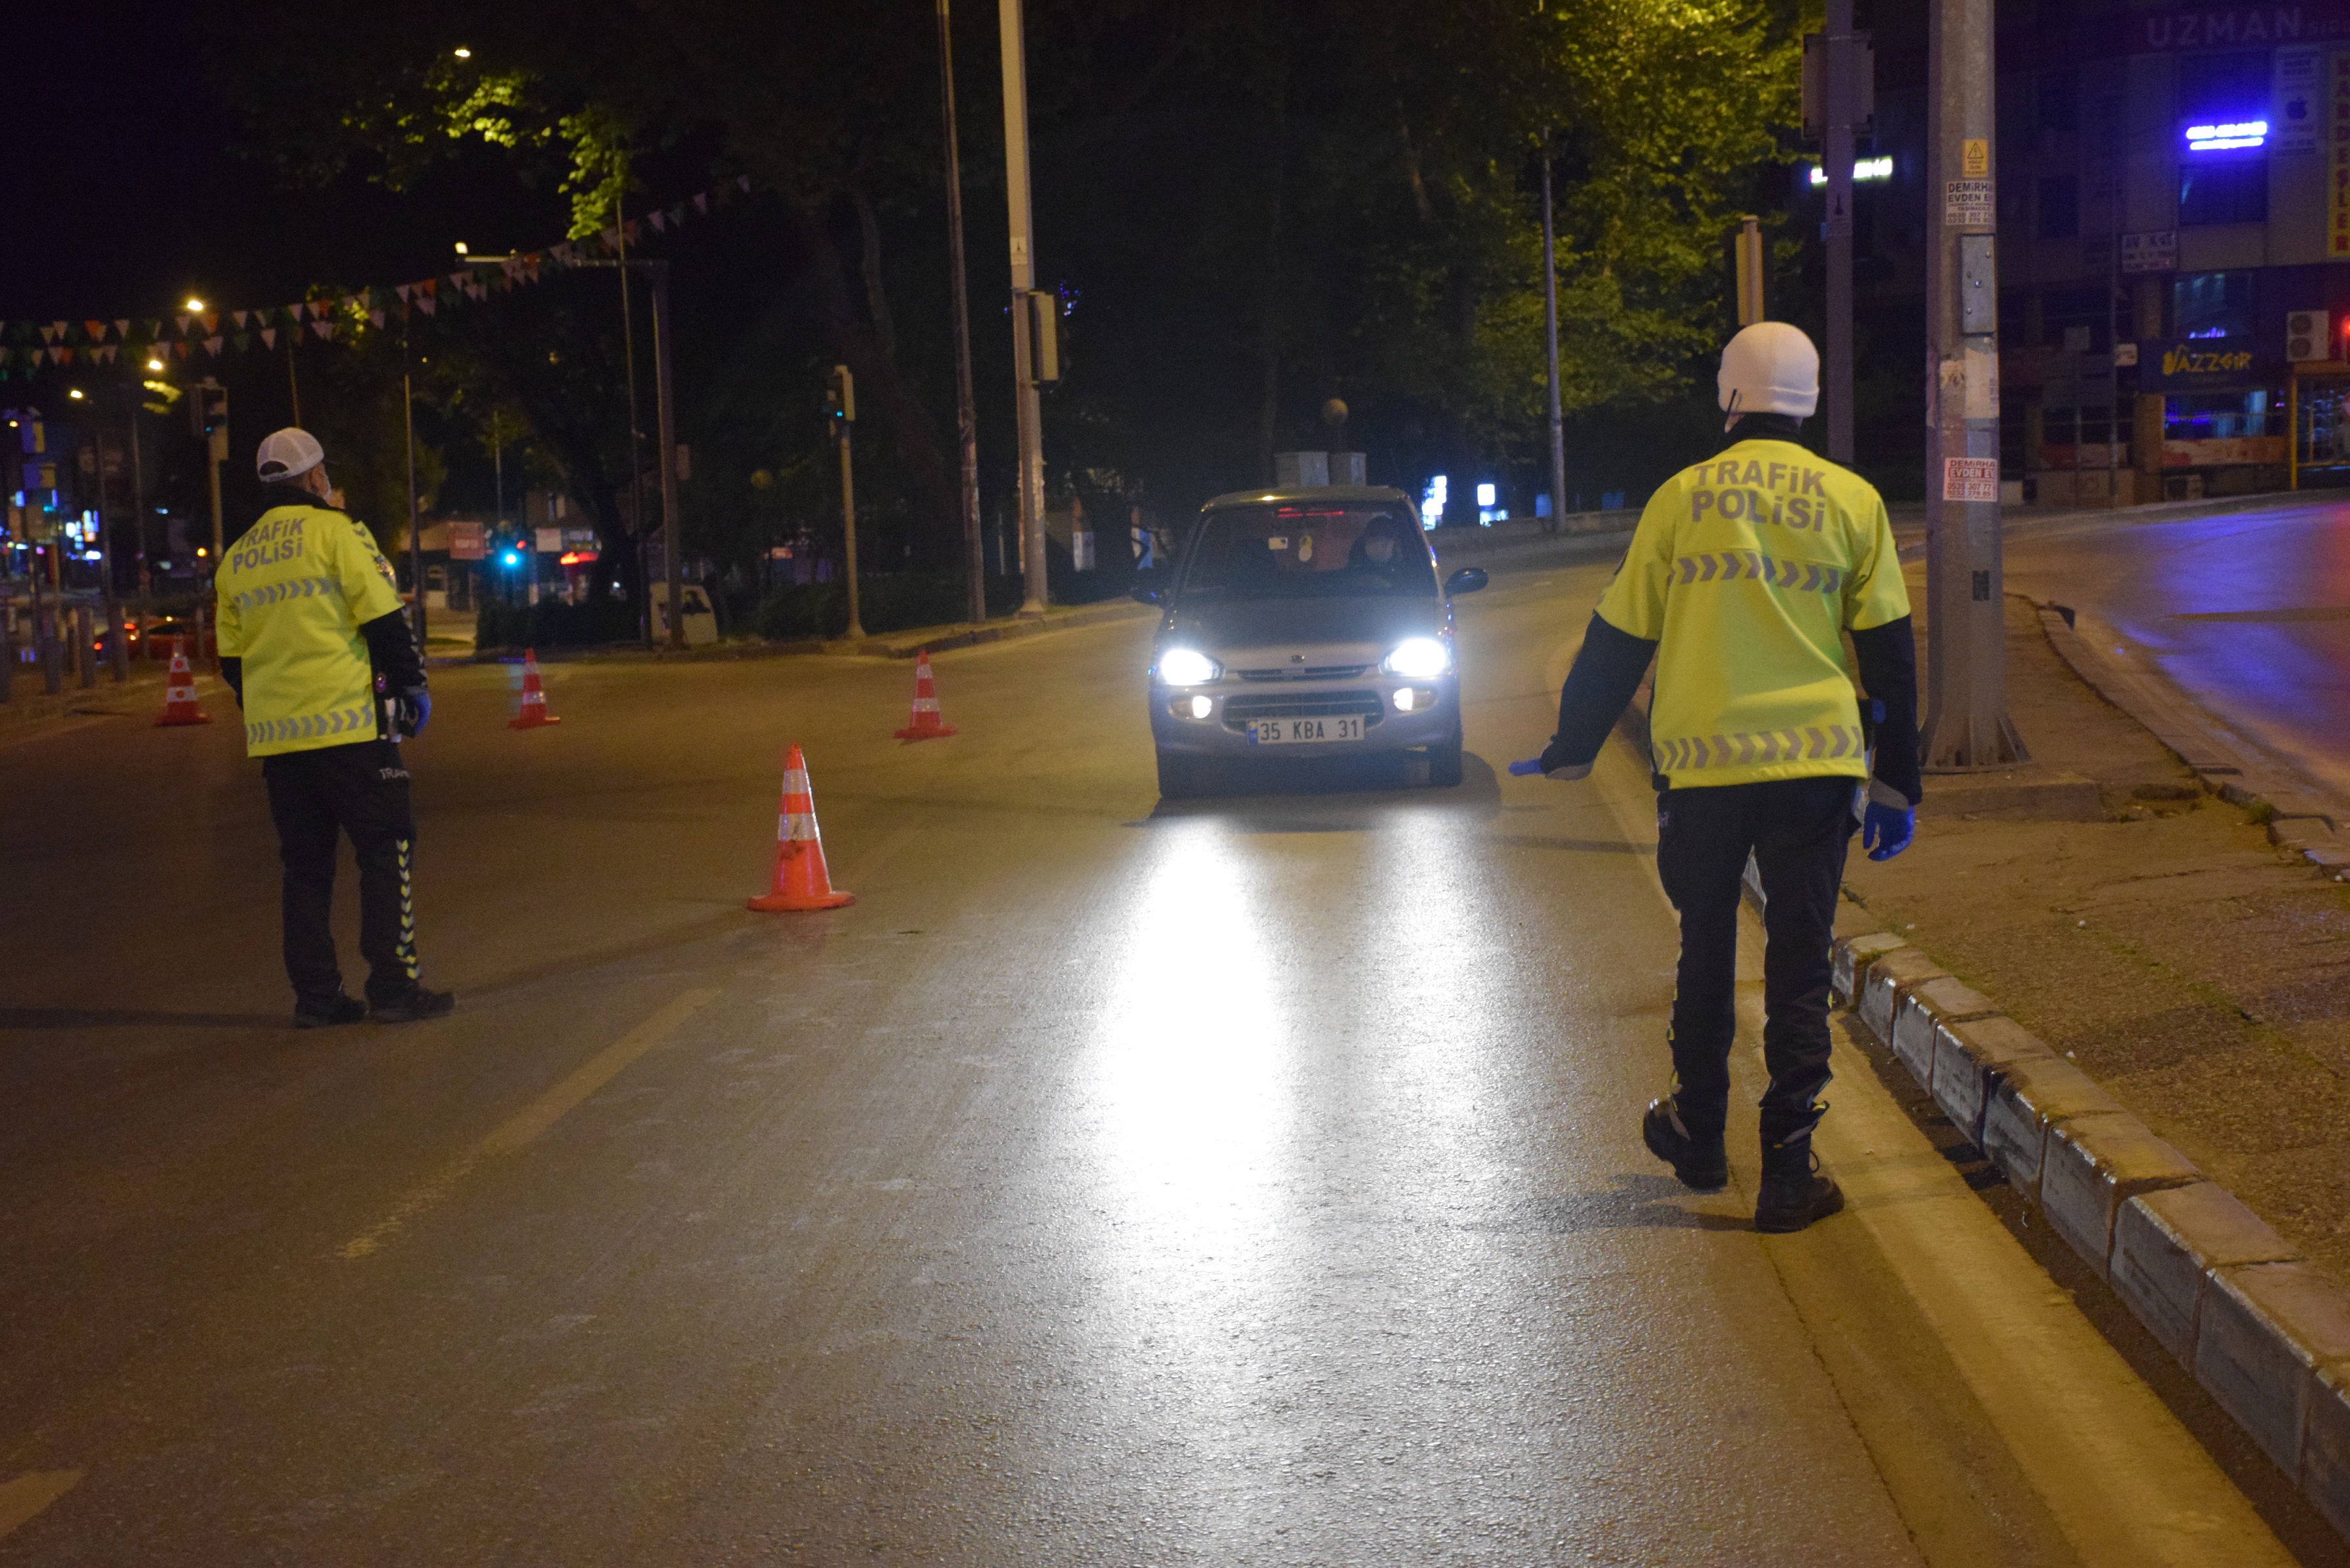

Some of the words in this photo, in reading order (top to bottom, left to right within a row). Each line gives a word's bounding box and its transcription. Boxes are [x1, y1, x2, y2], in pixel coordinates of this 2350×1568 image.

[2147, 7, 2300, 48] UZMAN
[1948, 193, 1981, 203] EVDEN
[1950, 468, 1982, 478] EVDEN
[1260, 722, 1281, 740] 35
[1293, 721, 1324, 740] KBA
[1338, 719, 1358, 738] 31
